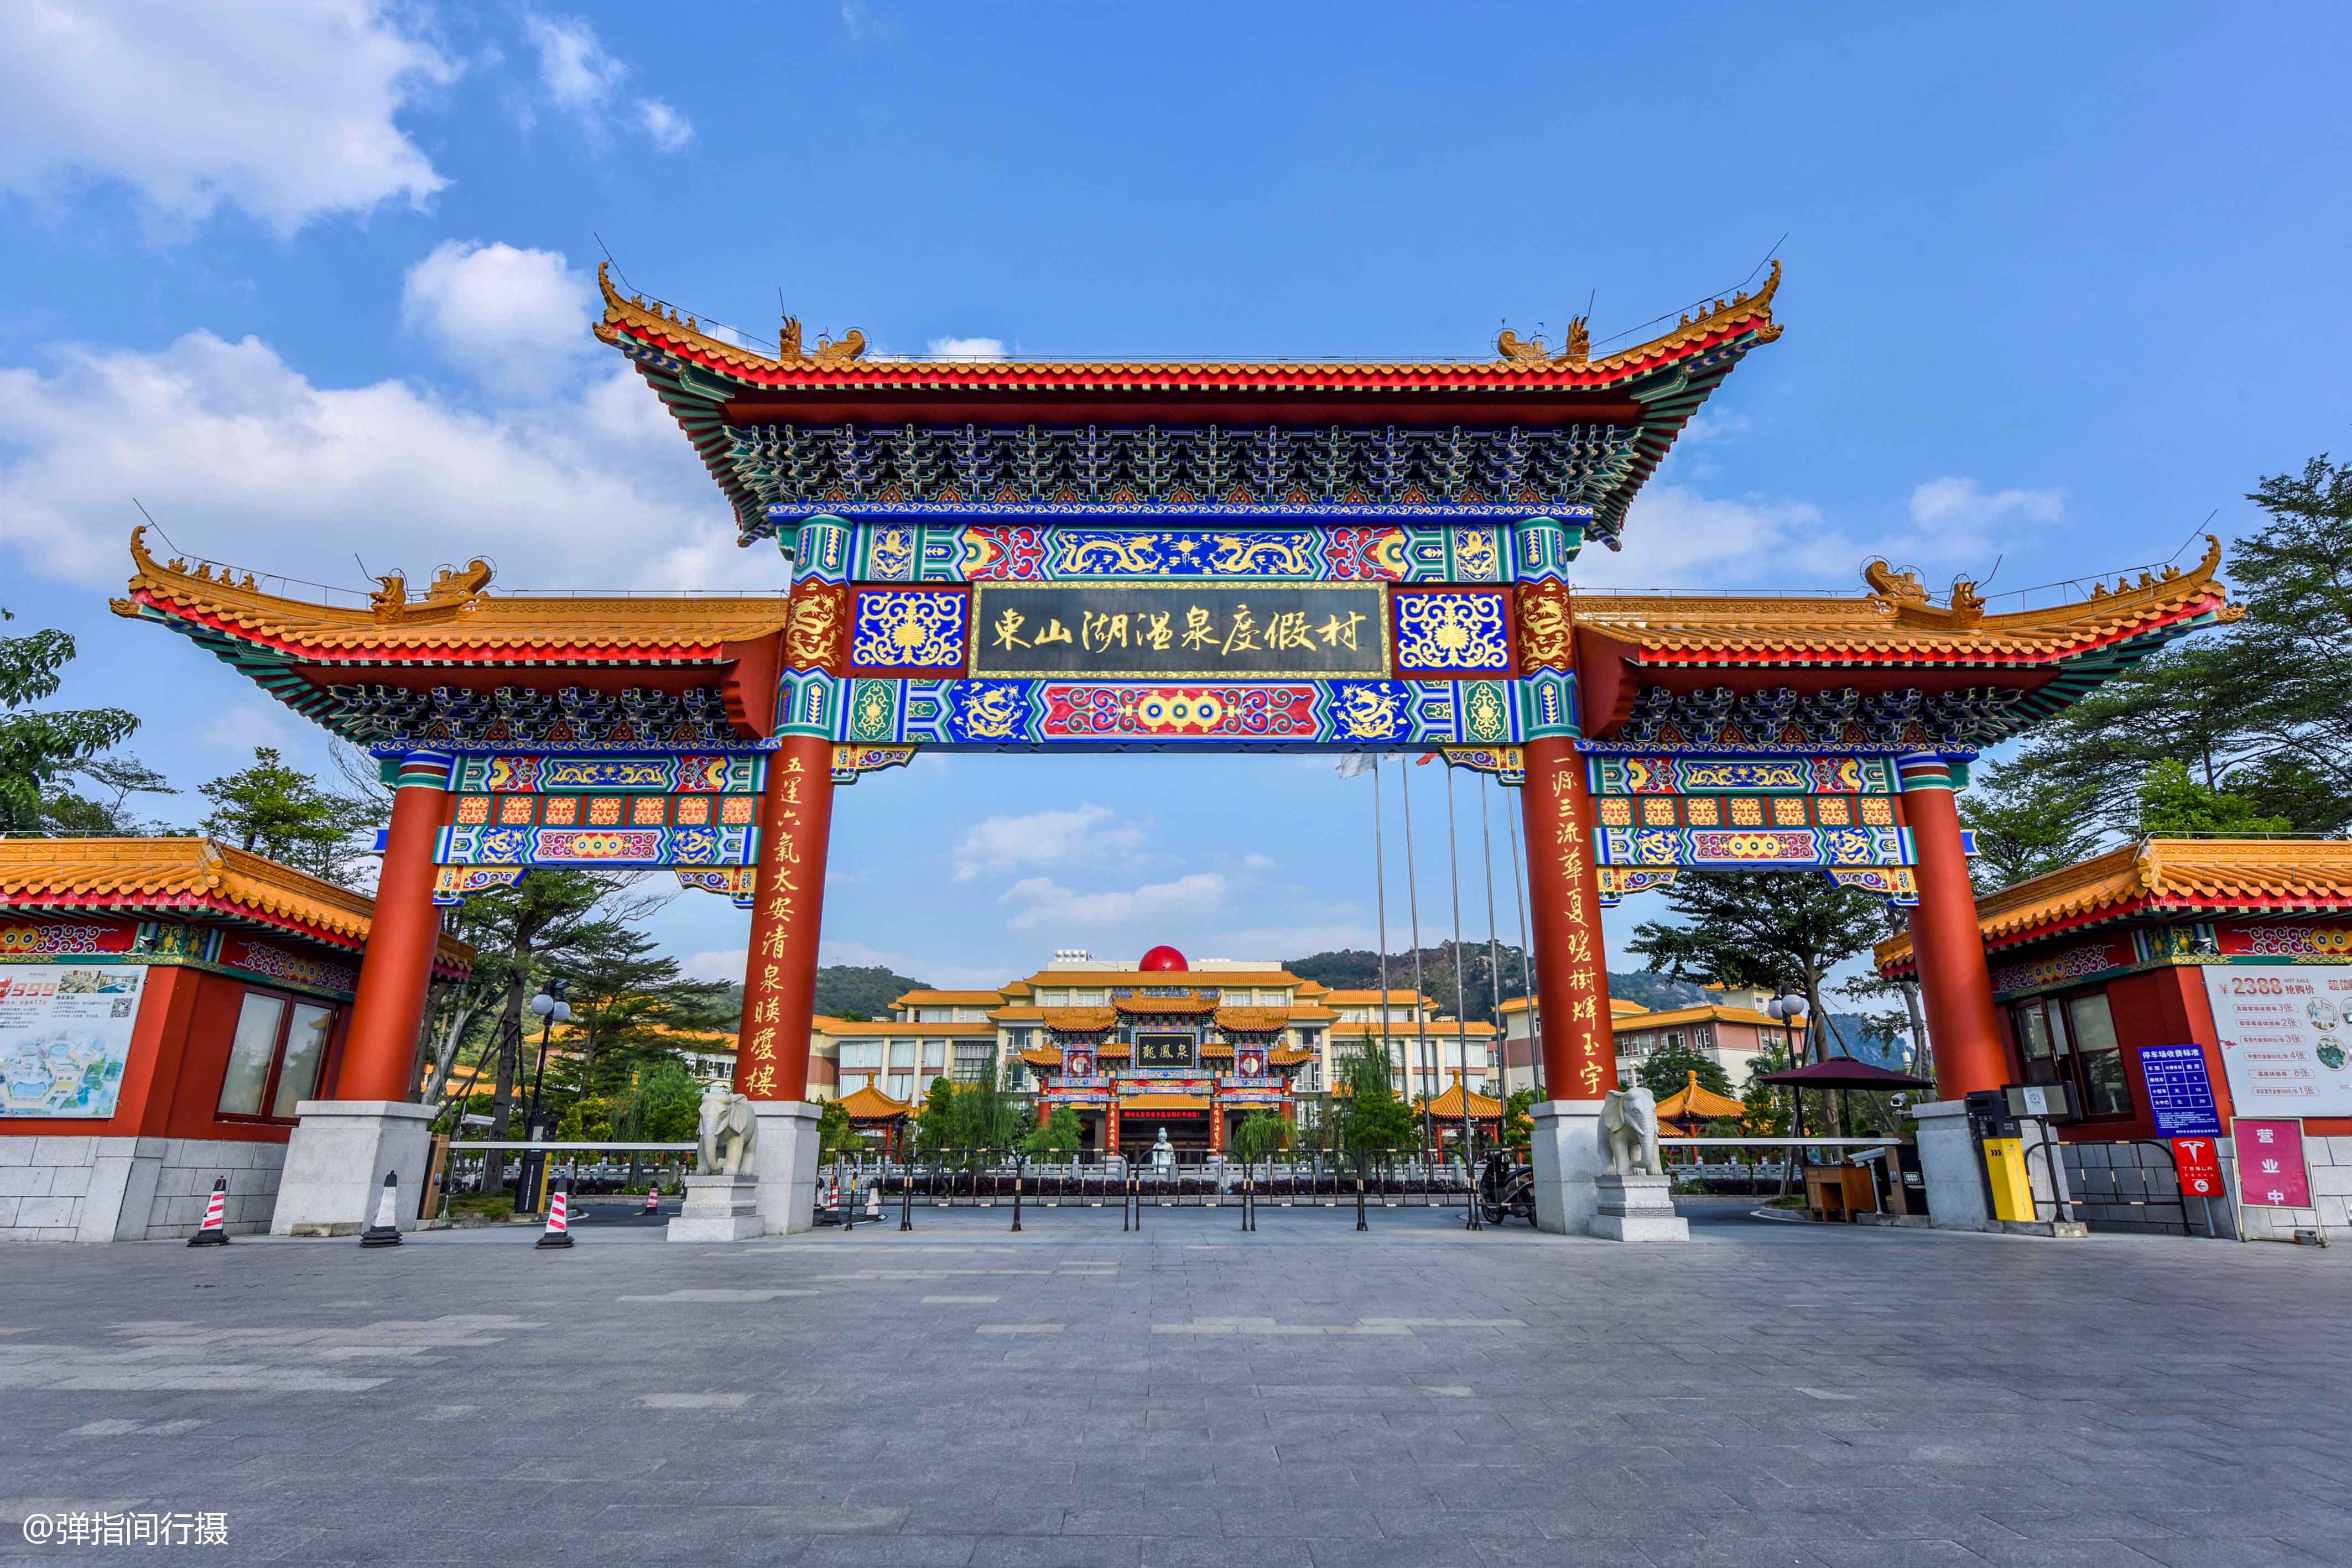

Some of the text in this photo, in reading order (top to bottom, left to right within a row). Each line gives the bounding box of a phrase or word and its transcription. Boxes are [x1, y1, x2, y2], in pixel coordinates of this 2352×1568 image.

[2285, 984, 2314, 995] 抢购价
[2142, 1049, 2200, 1059] 停车场收费标准
[2256, 1128, 2285, 1205] 营业中
